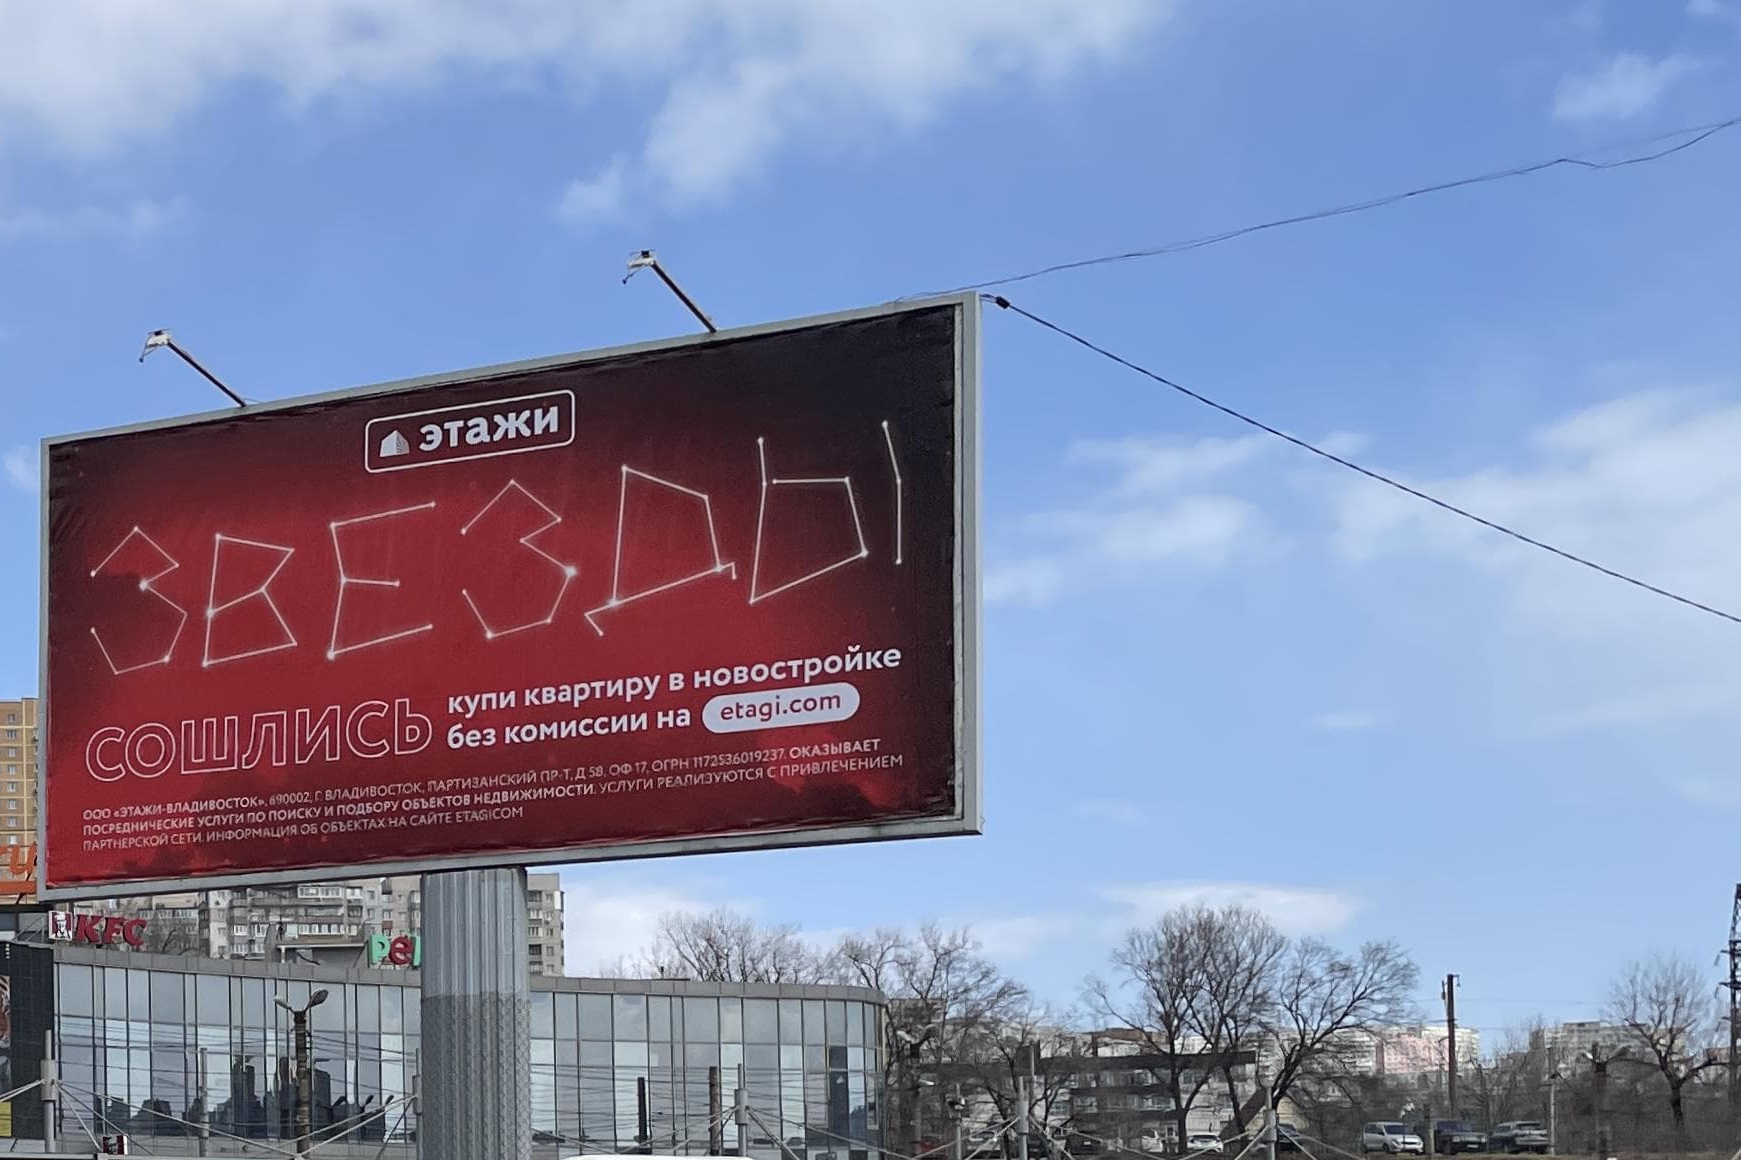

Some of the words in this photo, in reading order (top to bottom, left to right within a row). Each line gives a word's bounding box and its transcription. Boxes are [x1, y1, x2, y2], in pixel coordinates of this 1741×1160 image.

[418, 405, 559, 452] этажи
[90, 421, 905, 676] ЗВЕЗДЫ
[448, 689, 516, 719] купи
[524, 674, 661, 708] квартиру
[668, 672, 685, 692] в
[693, 644, 902, 689] новостройке
[720, 694, 841, 722] etagi.com
[85, 698, 433, 782] СОШЛИСЬ
[447, 723, 497, 750] без
[504, 711, 648, 744] комиссии
[657, 708, 691, 729] на
[83, 807, 111, 821] ООО
[427, 769, 537, 793] ПАРТИЗАНСКИЙ
[652, 756, 689, 772] ОГРН
[789, 738, 881, 759] ОКАЗЫВАЕТ
[83, 817, 194, 836] ПОСРЕДНИЧЕСКИЕ
[197, 812, 244, 828] УСЛУГИ
[246, 811, 266, 823] ПО
[269, 807, 321, 822] ПОИСКУ
[324, 805, 333, 817] И
[337, 801, 399, 817] ПОДБОРУ
[402, 795, 470, 812] ОБЪЕКТОВ
[600, 777, 654, 794] УСЛУГИ
[657, 767, 764, 789] РЕАЛИЗУЮТСЯ
[766, 765, 777, 779] С
[780, 754, 903, 777] ПРИВЛЕЧЕНИЕМ
[83, 832, 169, 851] ПАРТНЕРСКОЙ
[206, 824, 298, 843] ИНФОРМАЦИЯ
[300, 821, 317, 835] ОБ
[320, 816, 386, 834] ОБЪЕКТАХ
[388, 815, 408, 828] НА
[409, 809, 452, 826] САЙТЕ
[74, 913, 147, 947] KFC
